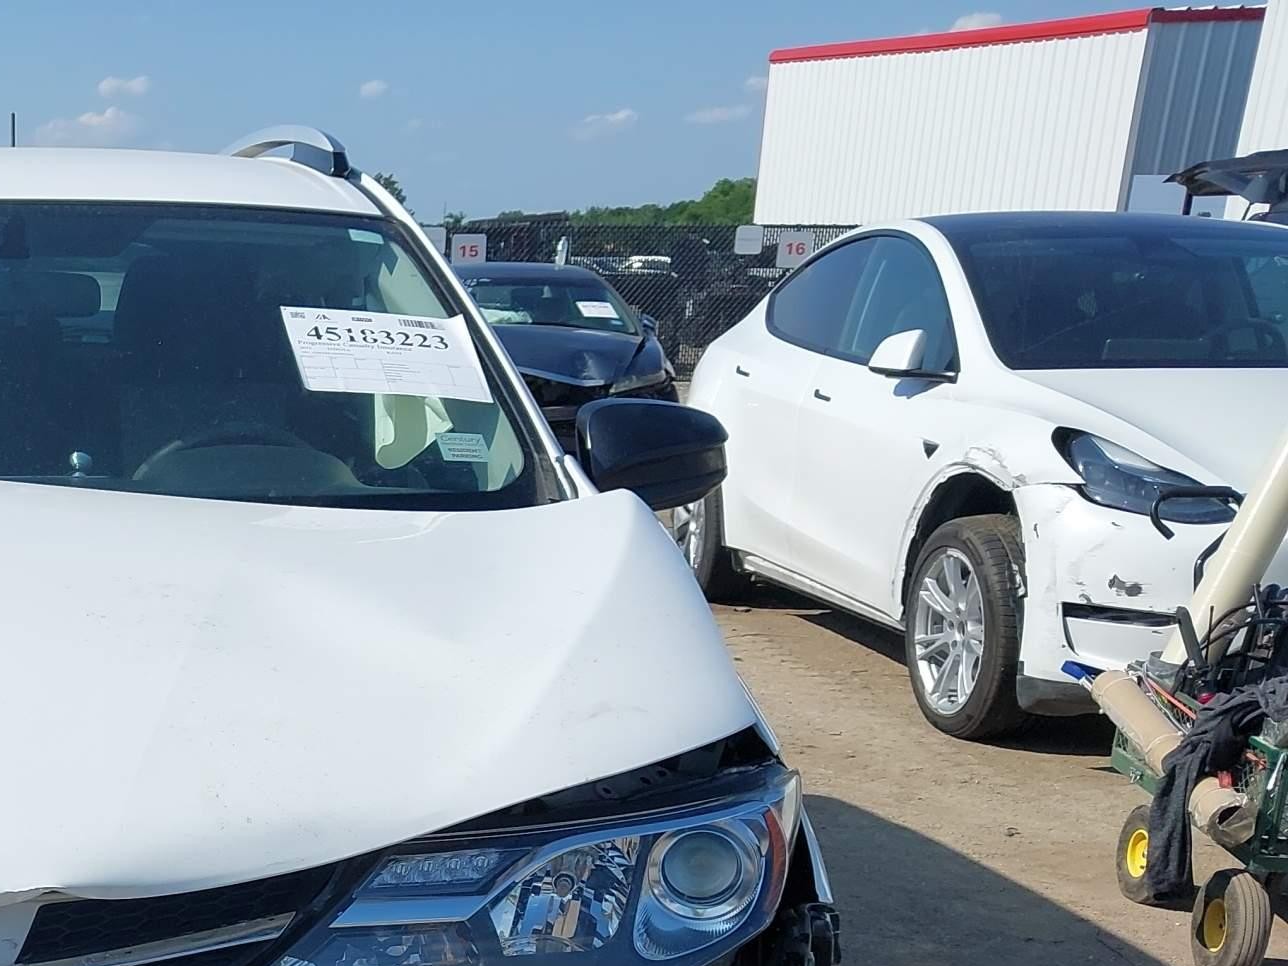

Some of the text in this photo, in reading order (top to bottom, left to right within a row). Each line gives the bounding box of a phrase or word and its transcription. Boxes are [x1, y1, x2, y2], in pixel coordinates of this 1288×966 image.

[459, 244, 479, 258] 15
[785, 242, 807, 256] 16
[306, 325, 450, 350] 45183223
